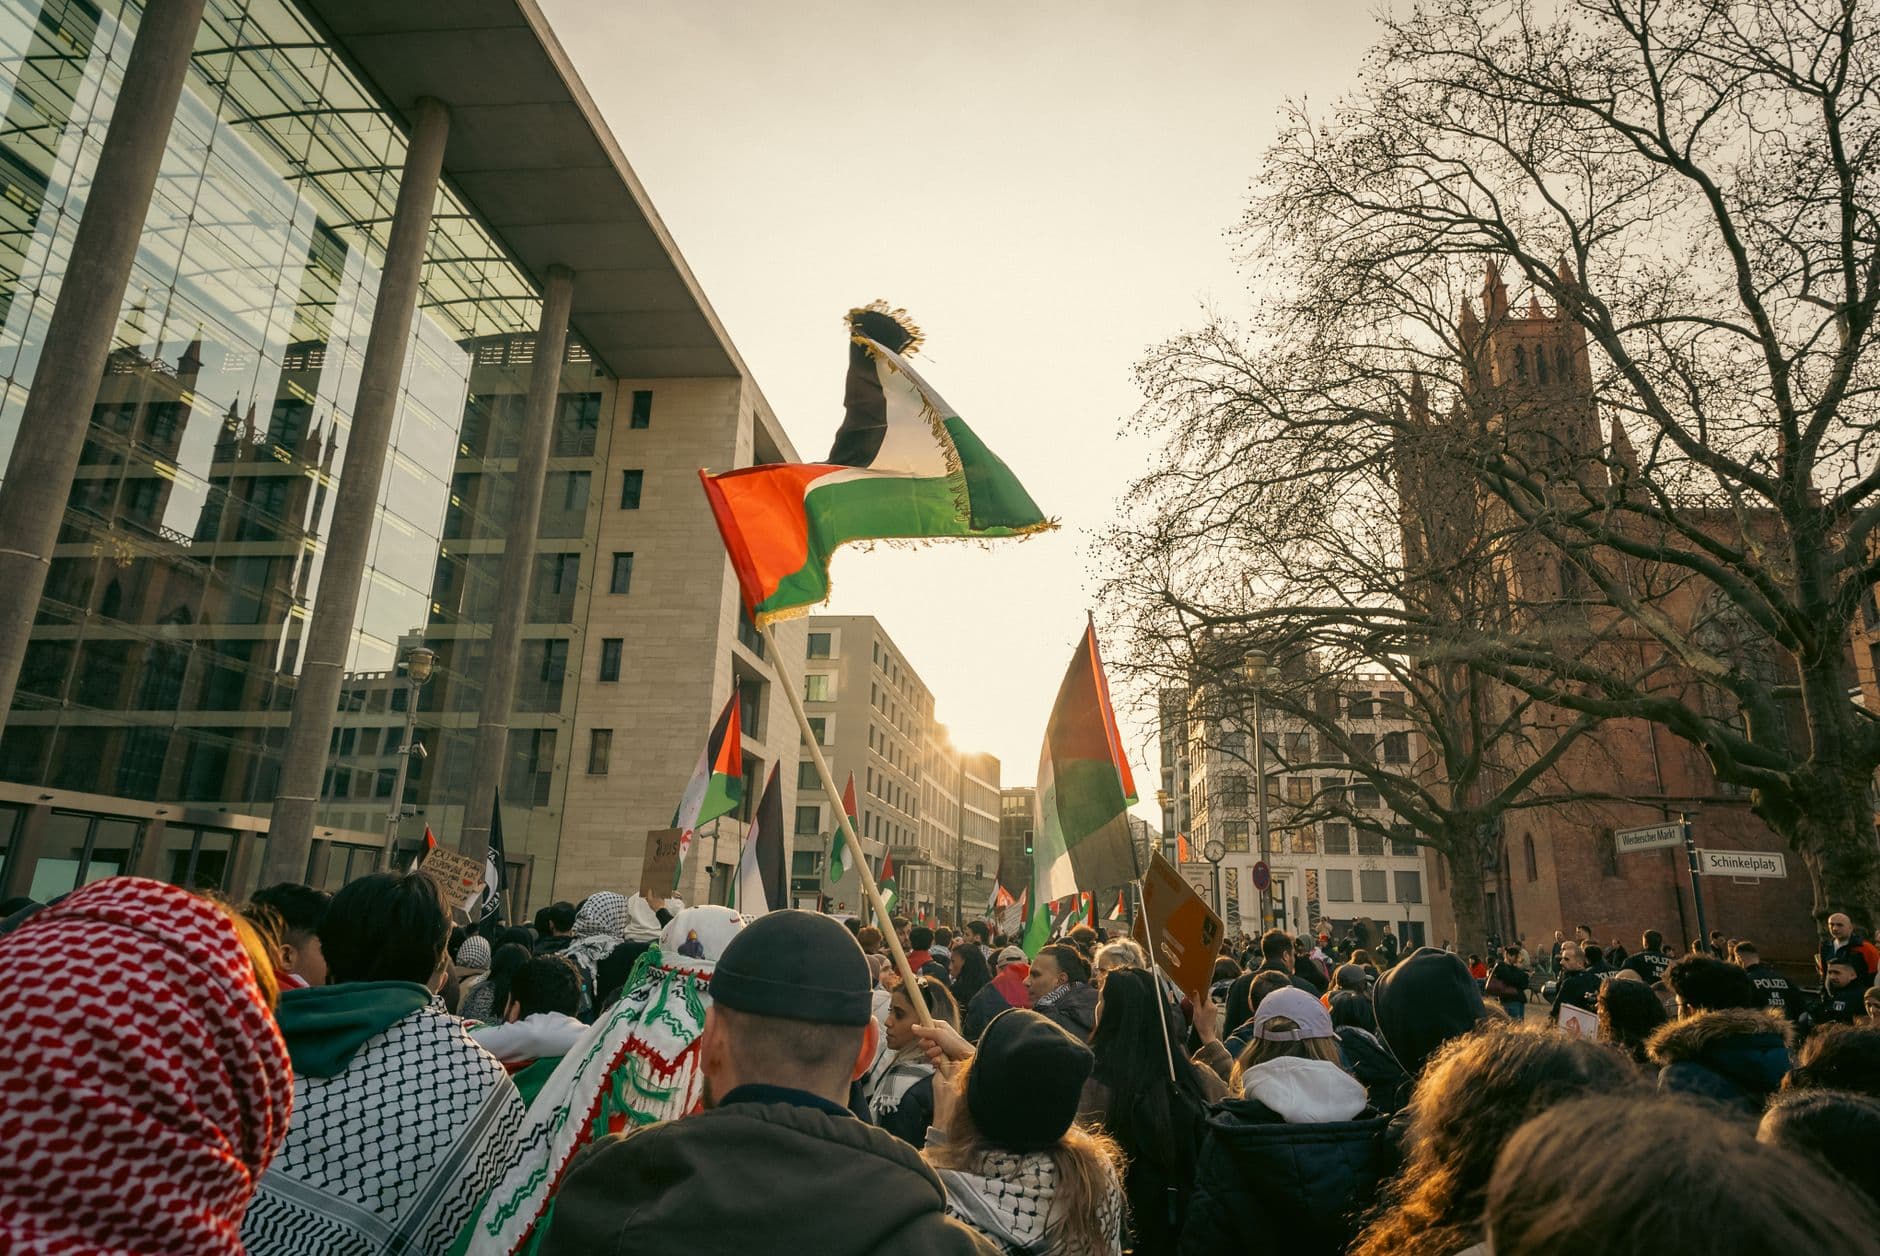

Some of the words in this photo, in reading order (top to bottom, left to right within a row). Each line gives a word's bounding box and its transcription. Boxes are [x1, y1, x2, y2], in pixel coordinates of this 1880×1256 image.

[1657, 828, 1676, 842] Markt
[1711, 855, 1776, 872] Schinkelplatz
[1753, 978, 1789, 989] POLIZEI
